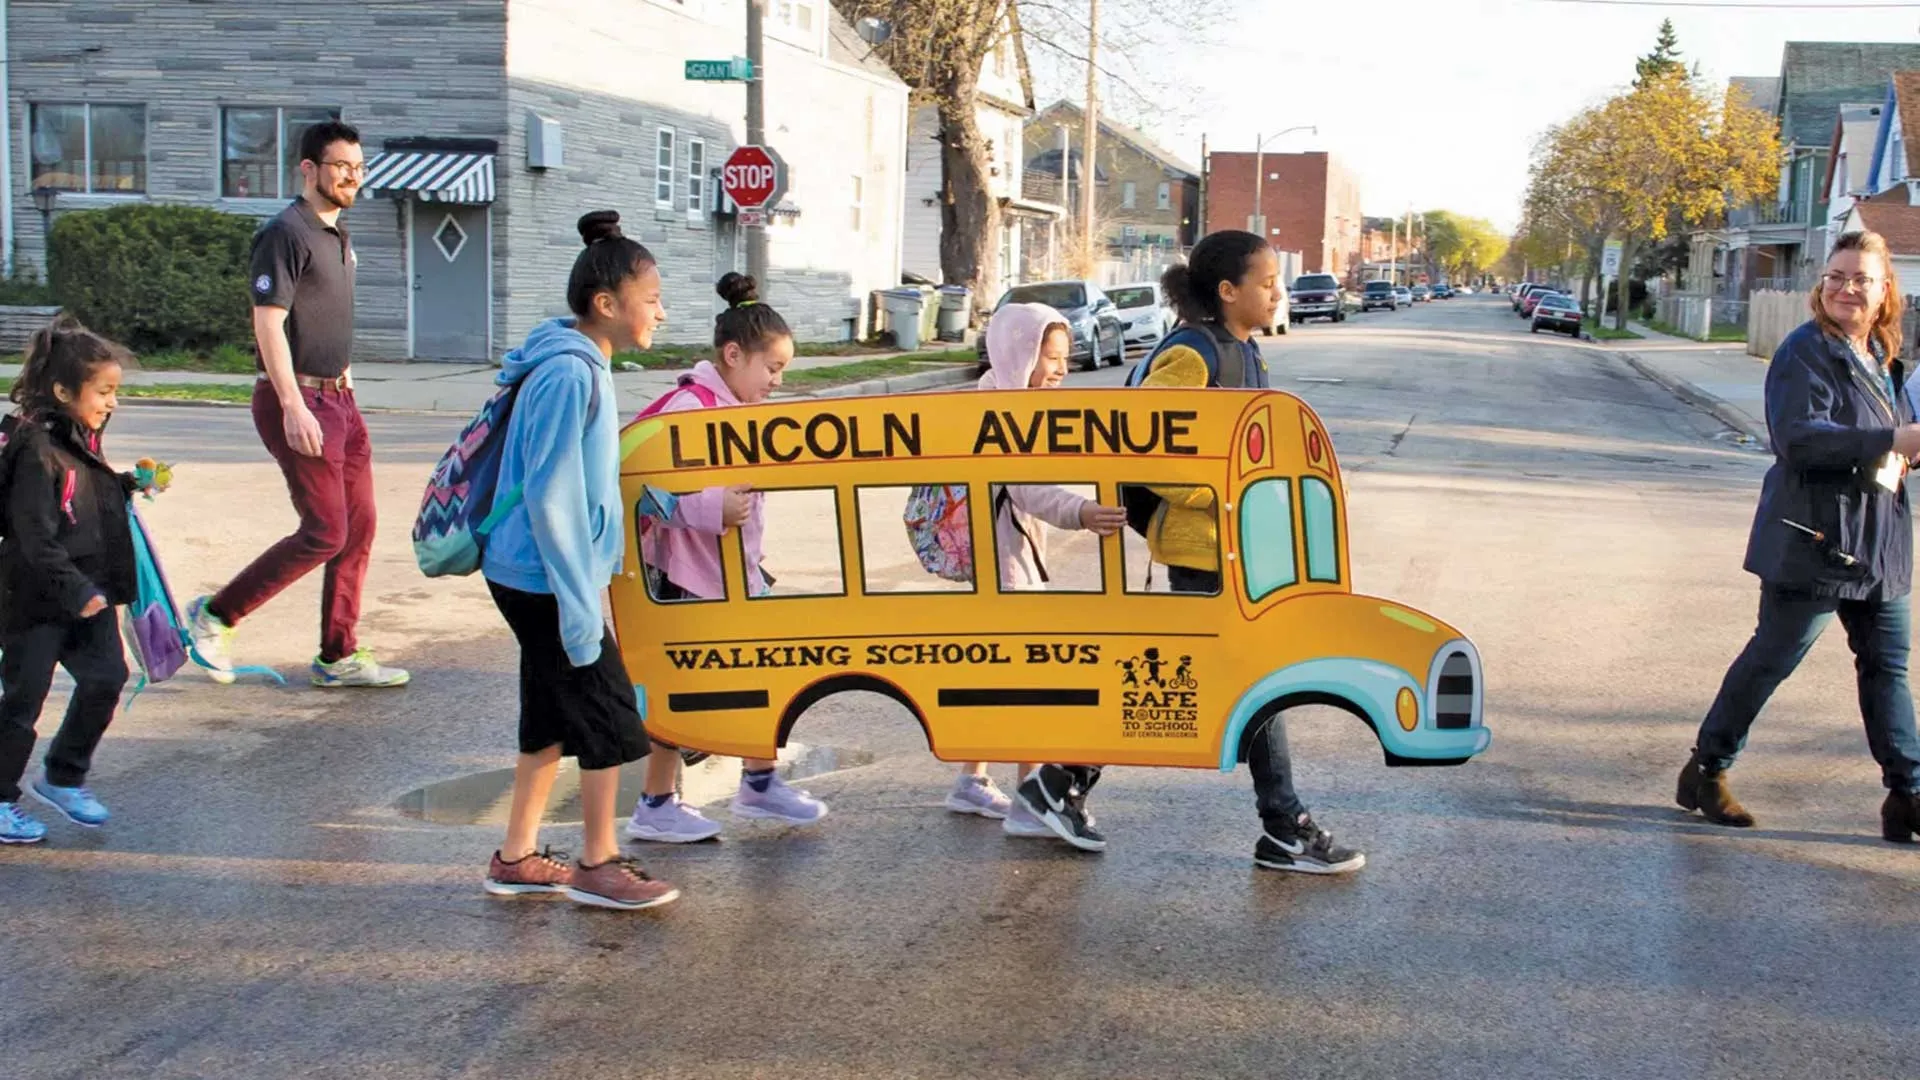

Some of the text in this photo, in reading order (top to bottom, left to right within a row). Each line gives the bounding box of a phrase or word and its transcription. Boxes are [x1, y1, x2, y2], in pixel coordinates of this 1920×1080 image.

[692, 63, 732, 78] GRANT
[725, 165, 774, 190] STOP
[670, 409, 1199, 468] LINCOLN AVENUE
[665, 643, 1101, 669] WALKING SCHOOL BUS
[1122, 691, 1198, 708] SAFE
[1122, 708, 1198, 721] ROUTES
[1122, 721, 1198, 731] TO SCHOOL
